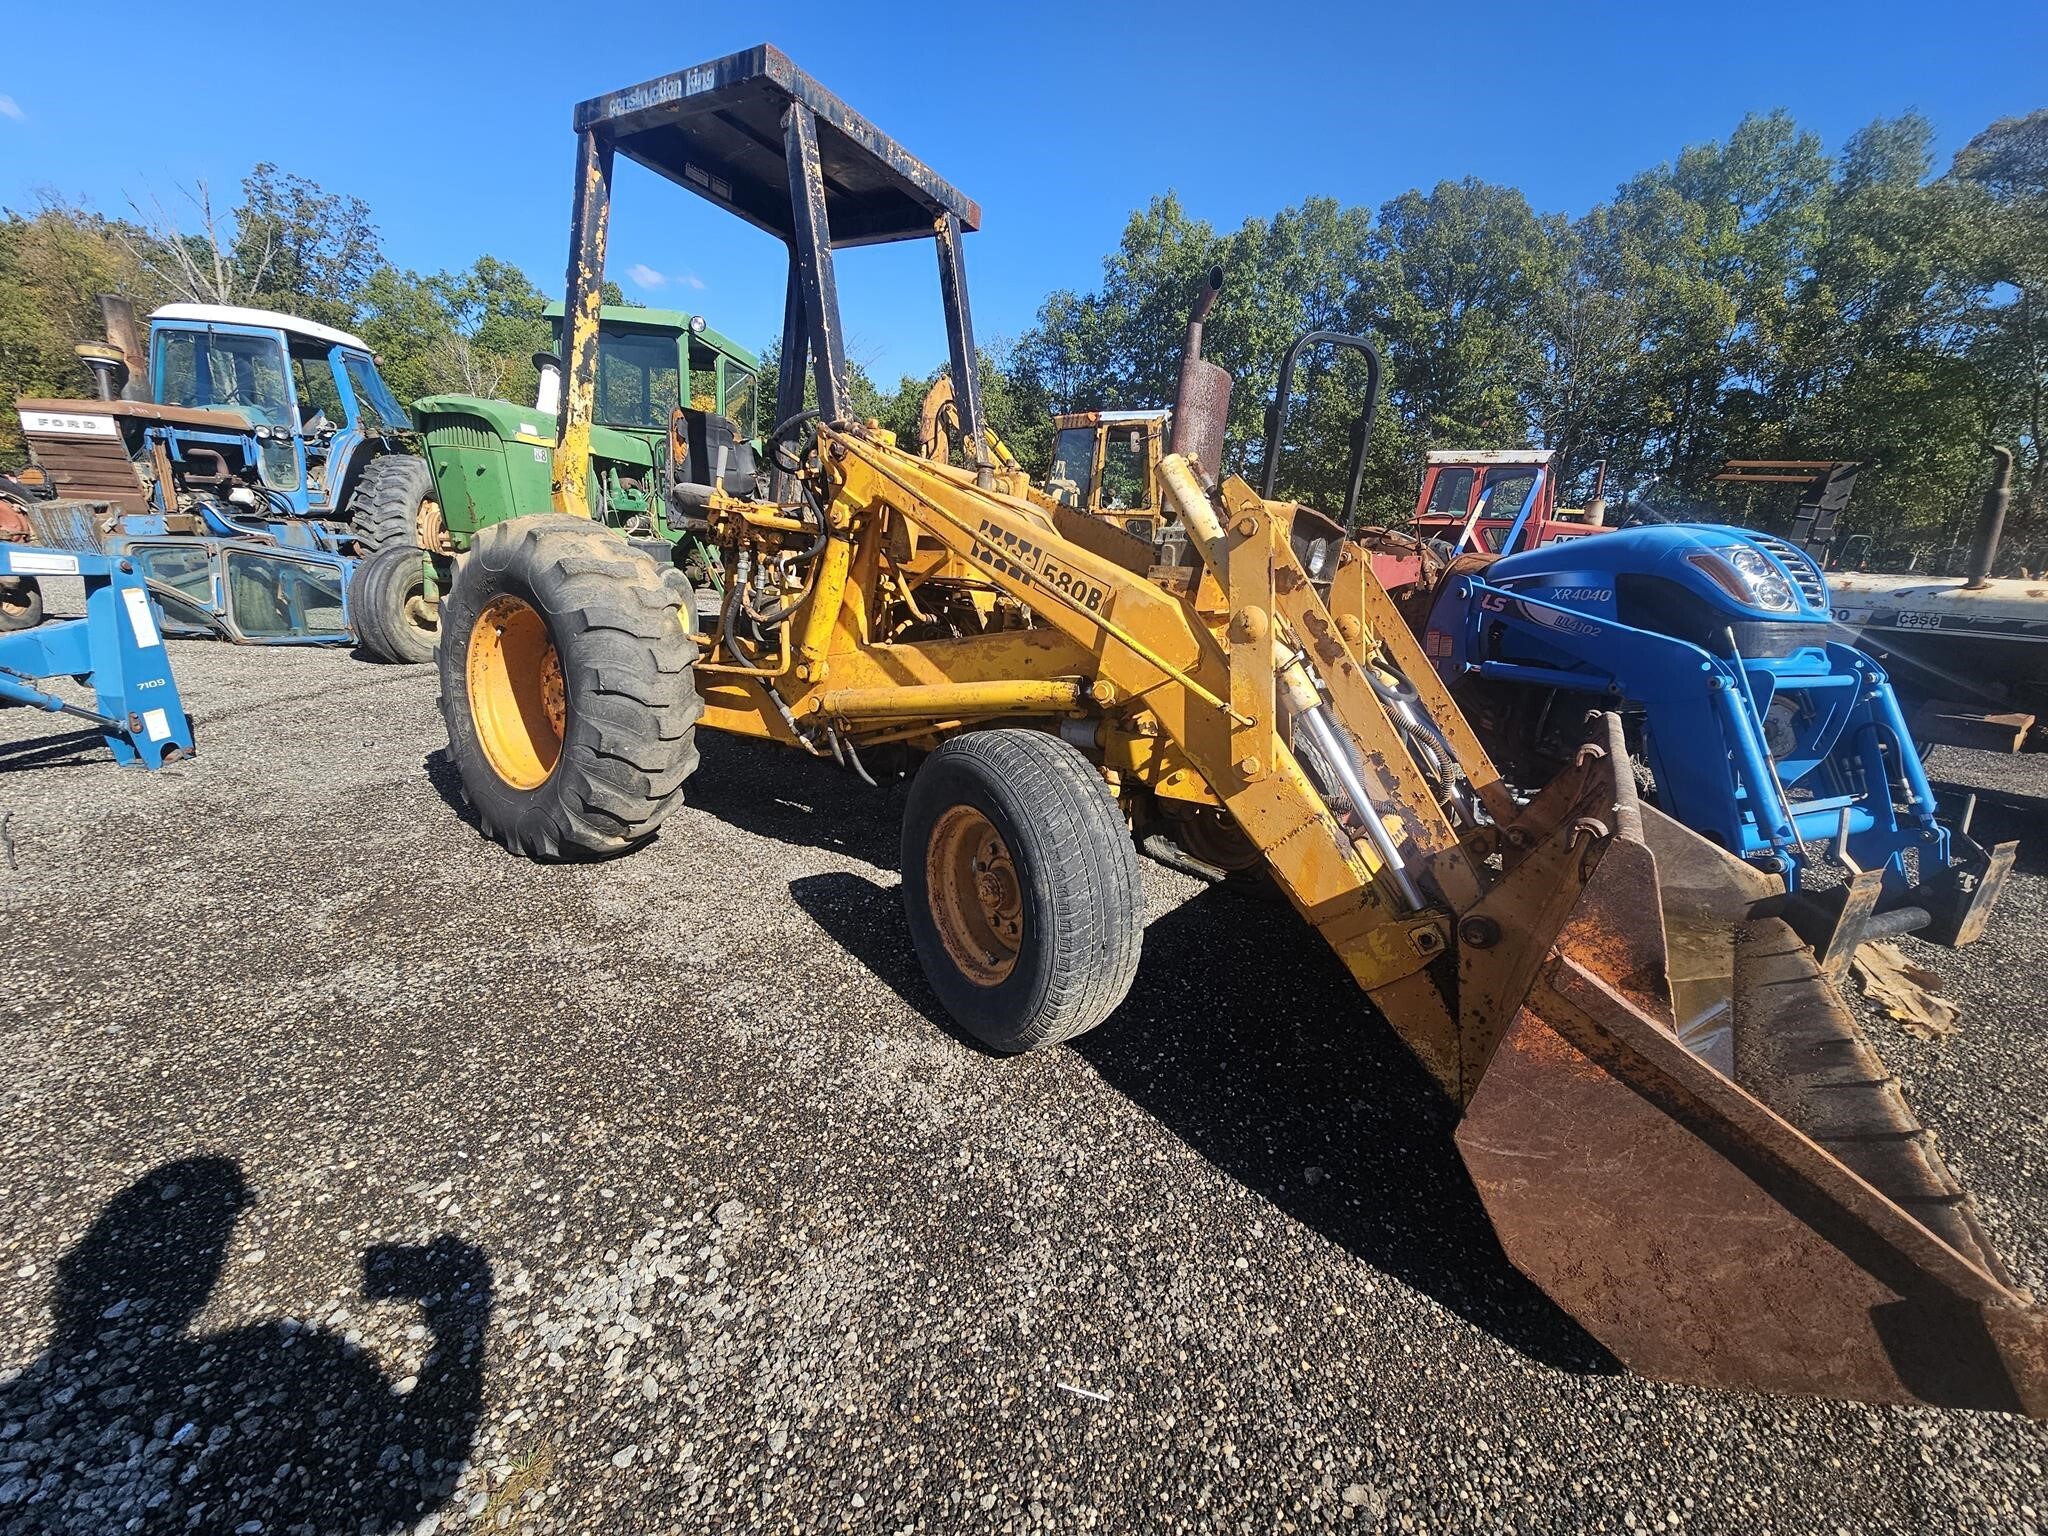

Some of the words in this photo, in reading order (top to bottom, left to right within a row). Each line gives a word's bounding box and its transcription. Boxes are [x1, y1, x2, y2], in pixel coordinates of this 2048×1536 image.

[686, 68, 715, 97] king
[38, 418, 96, 430] FORD
[1042, 562, 1103, 612] 580B
[1551, 588, 1613, 602] XR4040
[1482, 593, 1507, 613] LS
[137, 678, 166, 691] 7109
